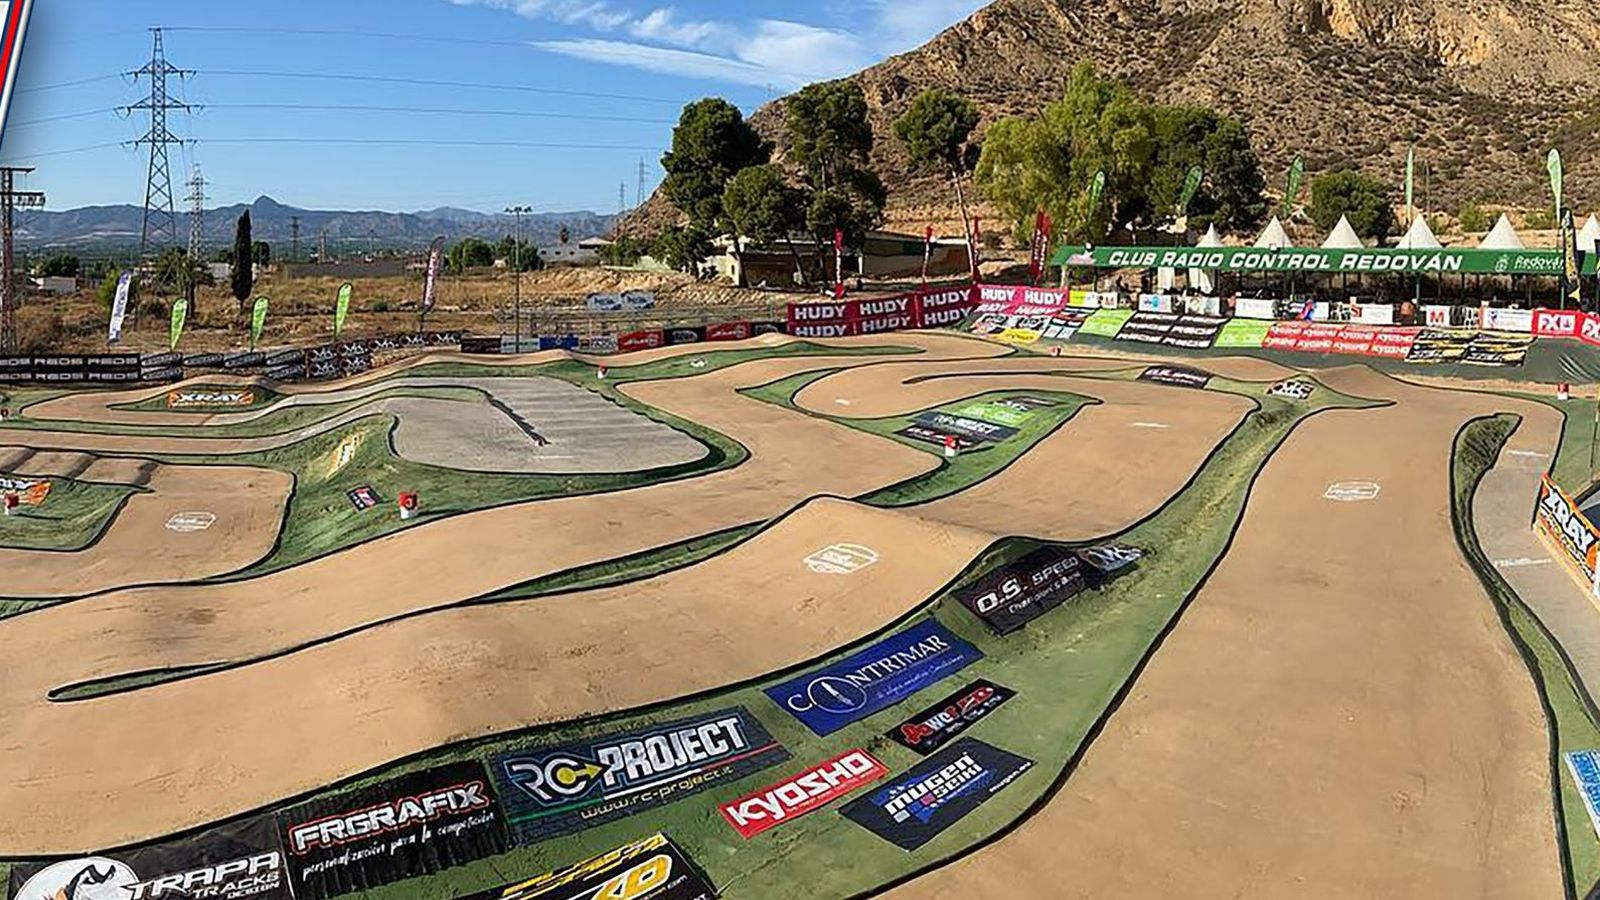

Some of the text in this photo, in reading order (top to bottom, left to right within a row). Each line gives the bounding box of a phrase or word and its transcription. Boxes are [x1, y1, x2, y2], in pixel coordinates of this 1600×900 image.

[1109, 252, 1463, 270] CLUB RADIO CONTROL REDOVÁN
[923, 289, 971, 307] HUDY
[981, 288, 1017, 301] HUDY
[1024, 290, 1064, 305] HUDY
[795, 305, 846, 319] HUDY
[860, 299, 908, 315] HUDY
[924, 307, 972, 325] HUDY
[796, 325, 847, 337] HUDY
[862, 317, 910, 332] HUDY
[976, 578, 1029, 614] O.S.
[1031, 556, 1079, 586] SPEED
[788, 634, 949, 714] CONTRIMAR
[511, 717, 746, 800] RC PROJECT
[580, 766, 734, 819] www.rc-project.it
[726, 751, 875, 827] KYOSHO
[294, 784, 486, 850] FRGRAFIX
[390, 834, 416, 856] para
[421, 819, 432, 844] la
[121, 851, 279, 900] TRAPA
[192, 870, 279, 900] TRACKS
